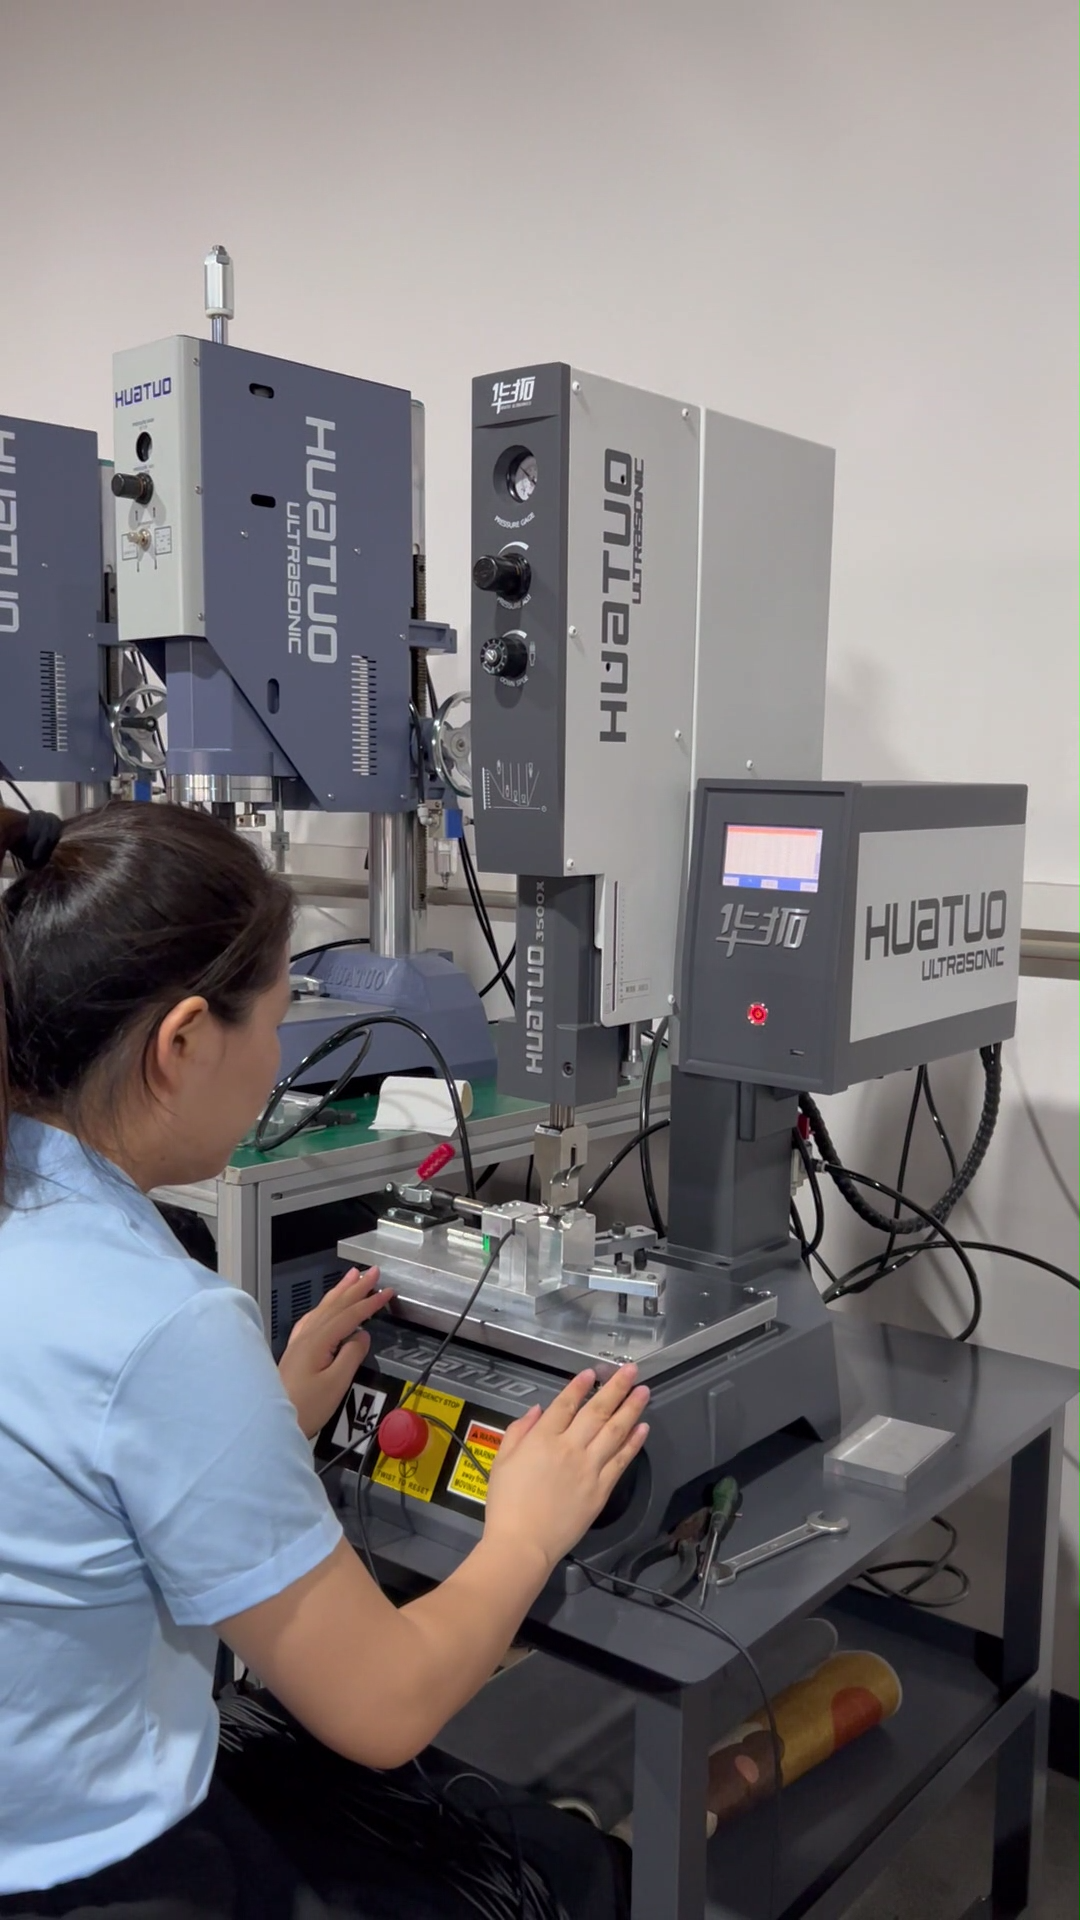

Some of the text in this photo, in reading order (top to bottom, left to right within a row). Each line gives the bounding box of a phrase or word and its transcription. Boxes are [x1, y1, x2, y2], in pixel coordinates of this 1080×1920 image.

[443, 1398, 460, 1409] STOP
[377, 1469, 396, 1482] TWIST
[408, 1481, 429, 1495] RESET
